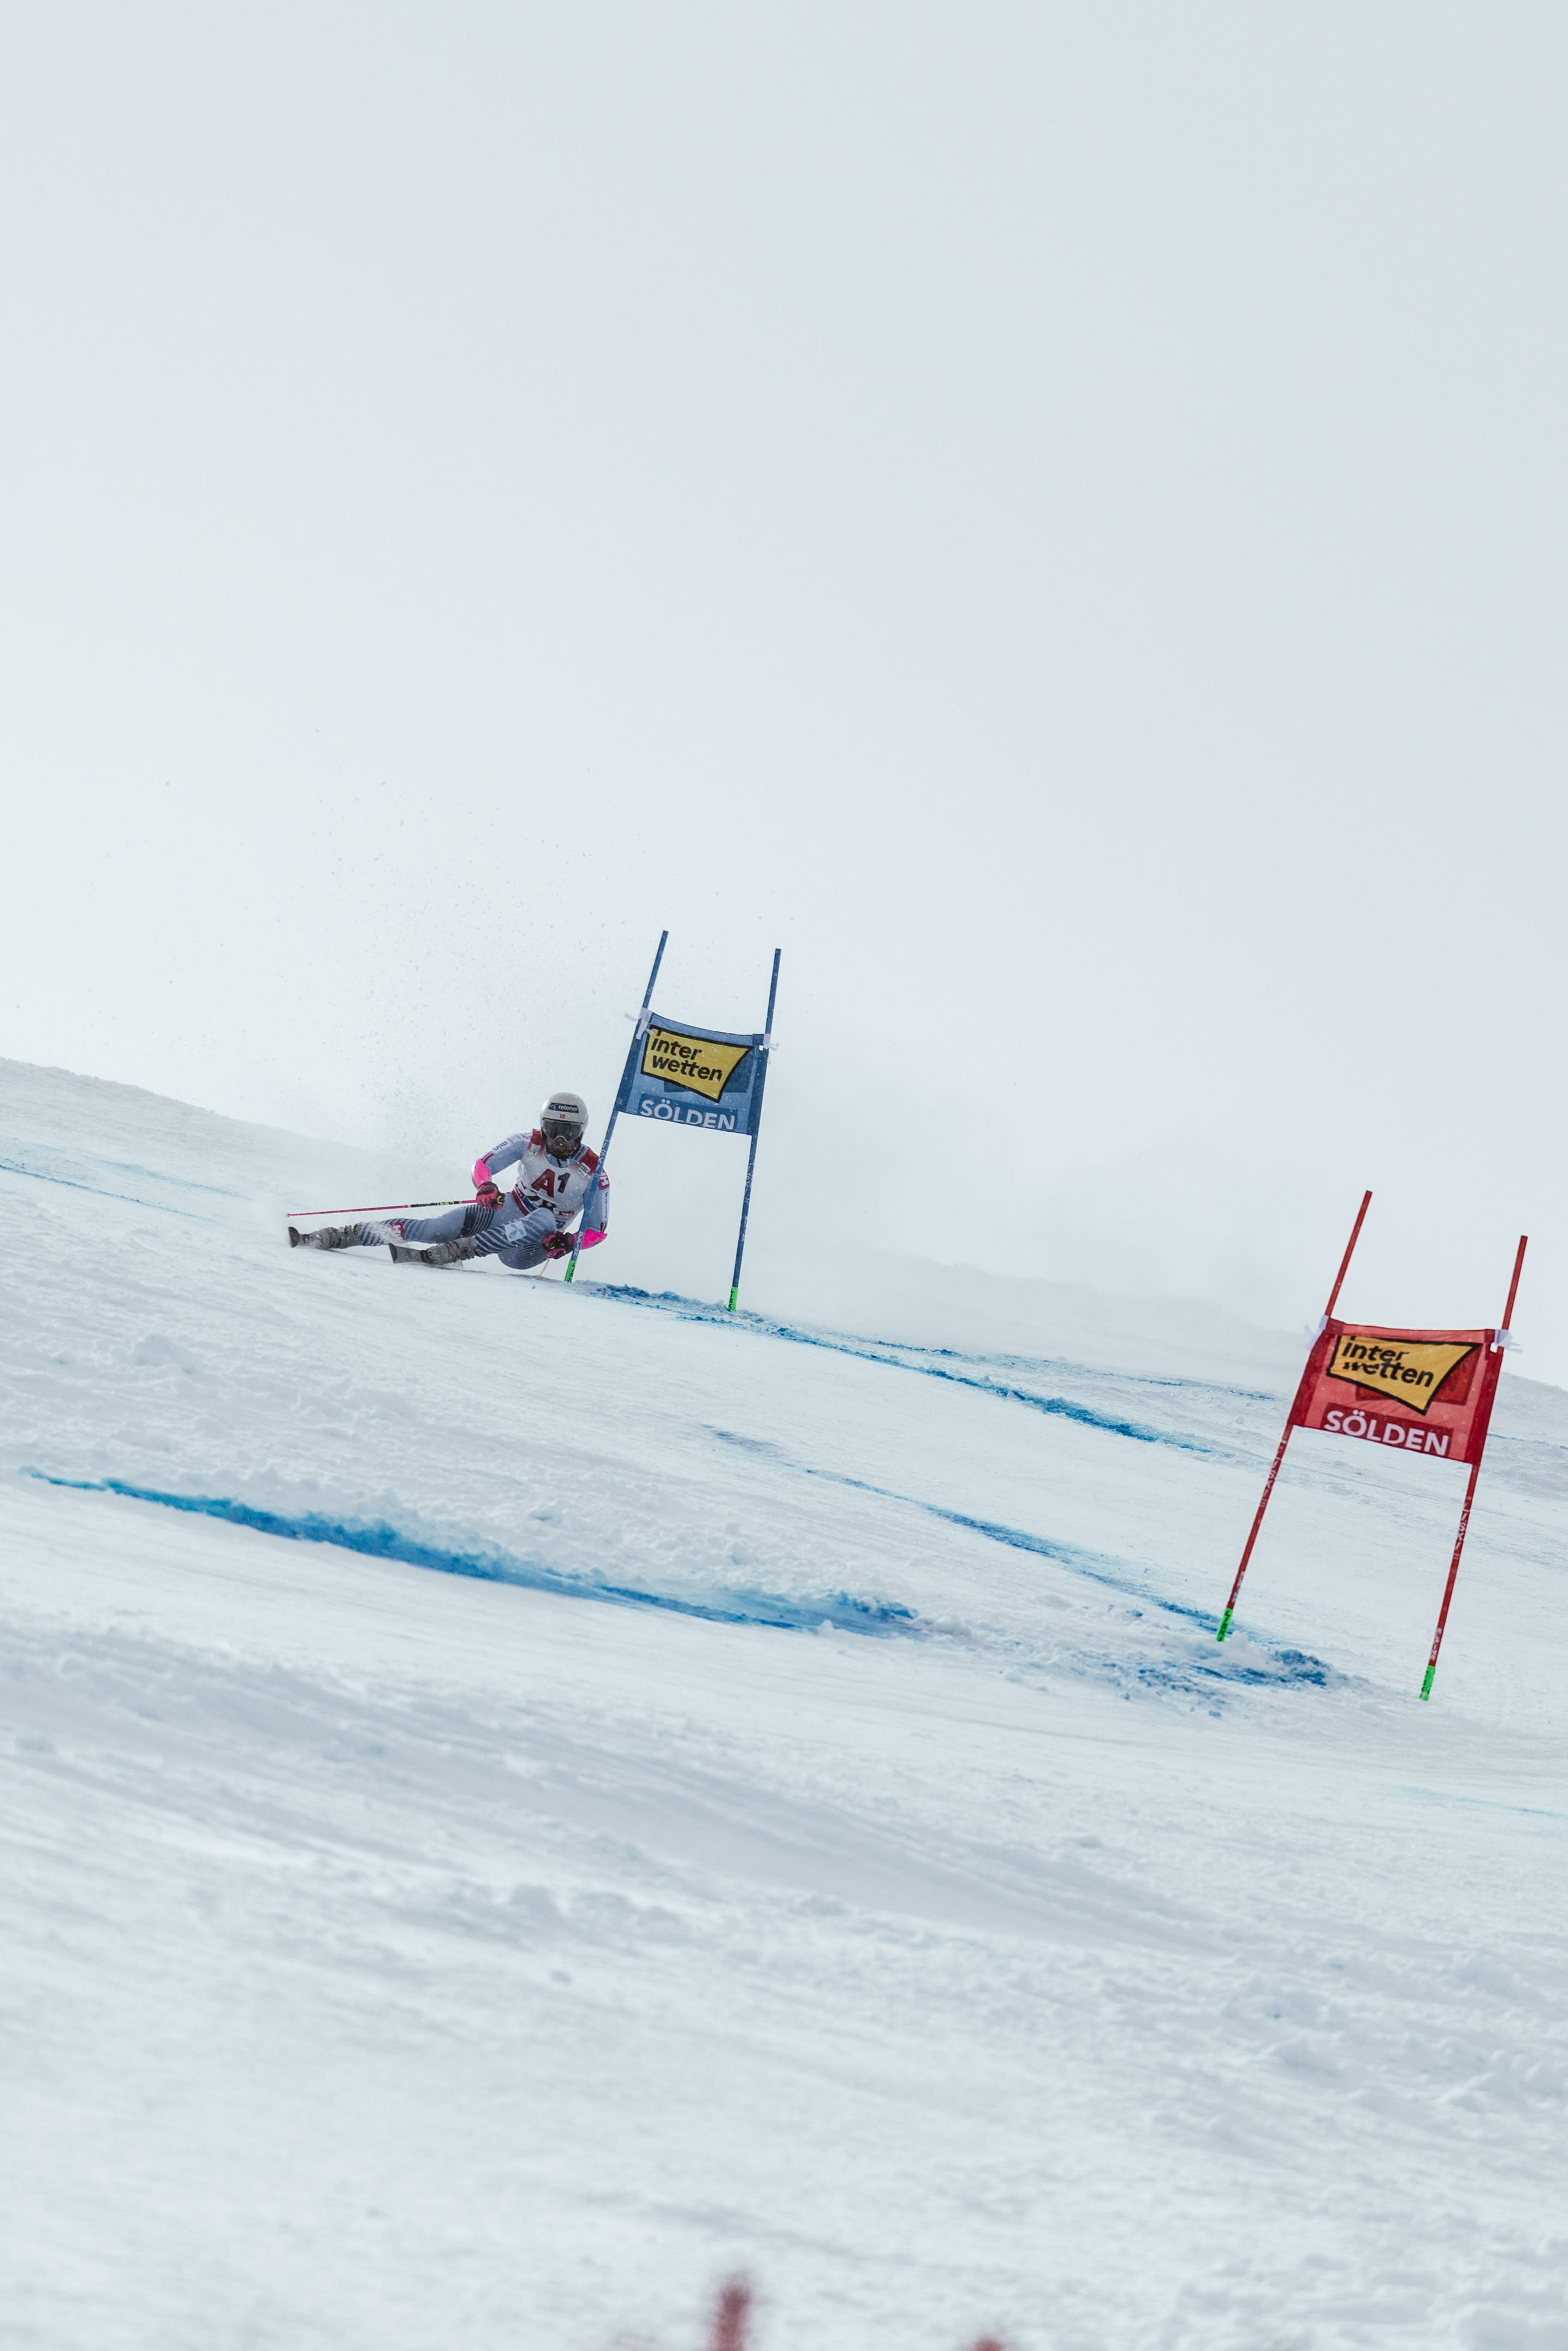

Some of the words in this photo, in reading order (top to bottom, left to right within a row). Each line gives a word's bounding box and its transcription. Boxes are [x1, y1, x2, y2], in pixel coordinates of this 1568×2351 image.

[651, 1032, 703, 1060] inter
[652, 1055, 722, 1082] wetten
[640, 1099, 735, 1130] SÖLDEN
[531, 1168, 571, 1198] A1
[1342, 1335, 1409, 1362] inter
[1343, 1362, 1434, 1387] wetten
[1324, 1409, 1450, 1456] SÖLDEN
